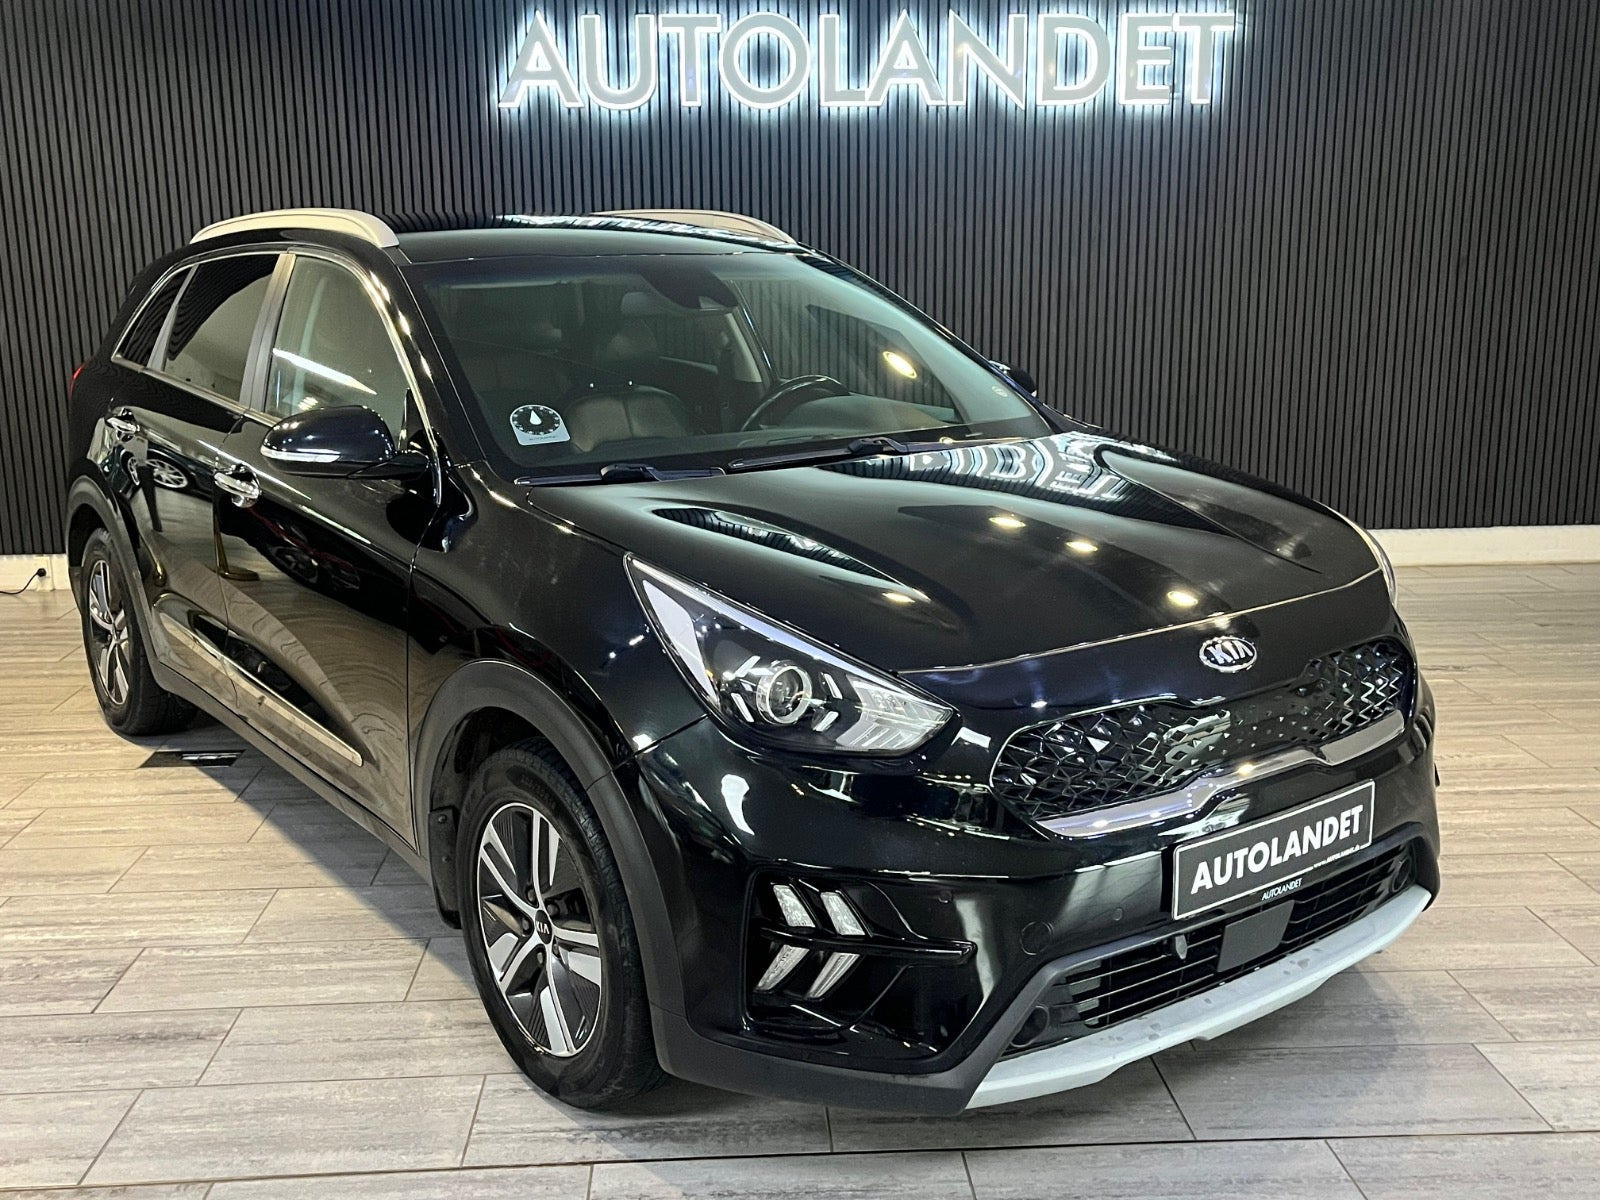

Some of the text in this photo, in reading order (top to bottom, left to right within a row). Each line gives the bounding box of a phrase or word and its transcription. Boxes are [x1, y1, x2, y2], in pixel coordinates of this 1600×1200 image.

[498, 9, 1235, 109] AUTOLANDET
[1206, 640, 1253, 665] KIA
[1190, 804, 1364, 895] AUTOLANDET
[1261, 878, 1302, 901] AUTOLANDET
